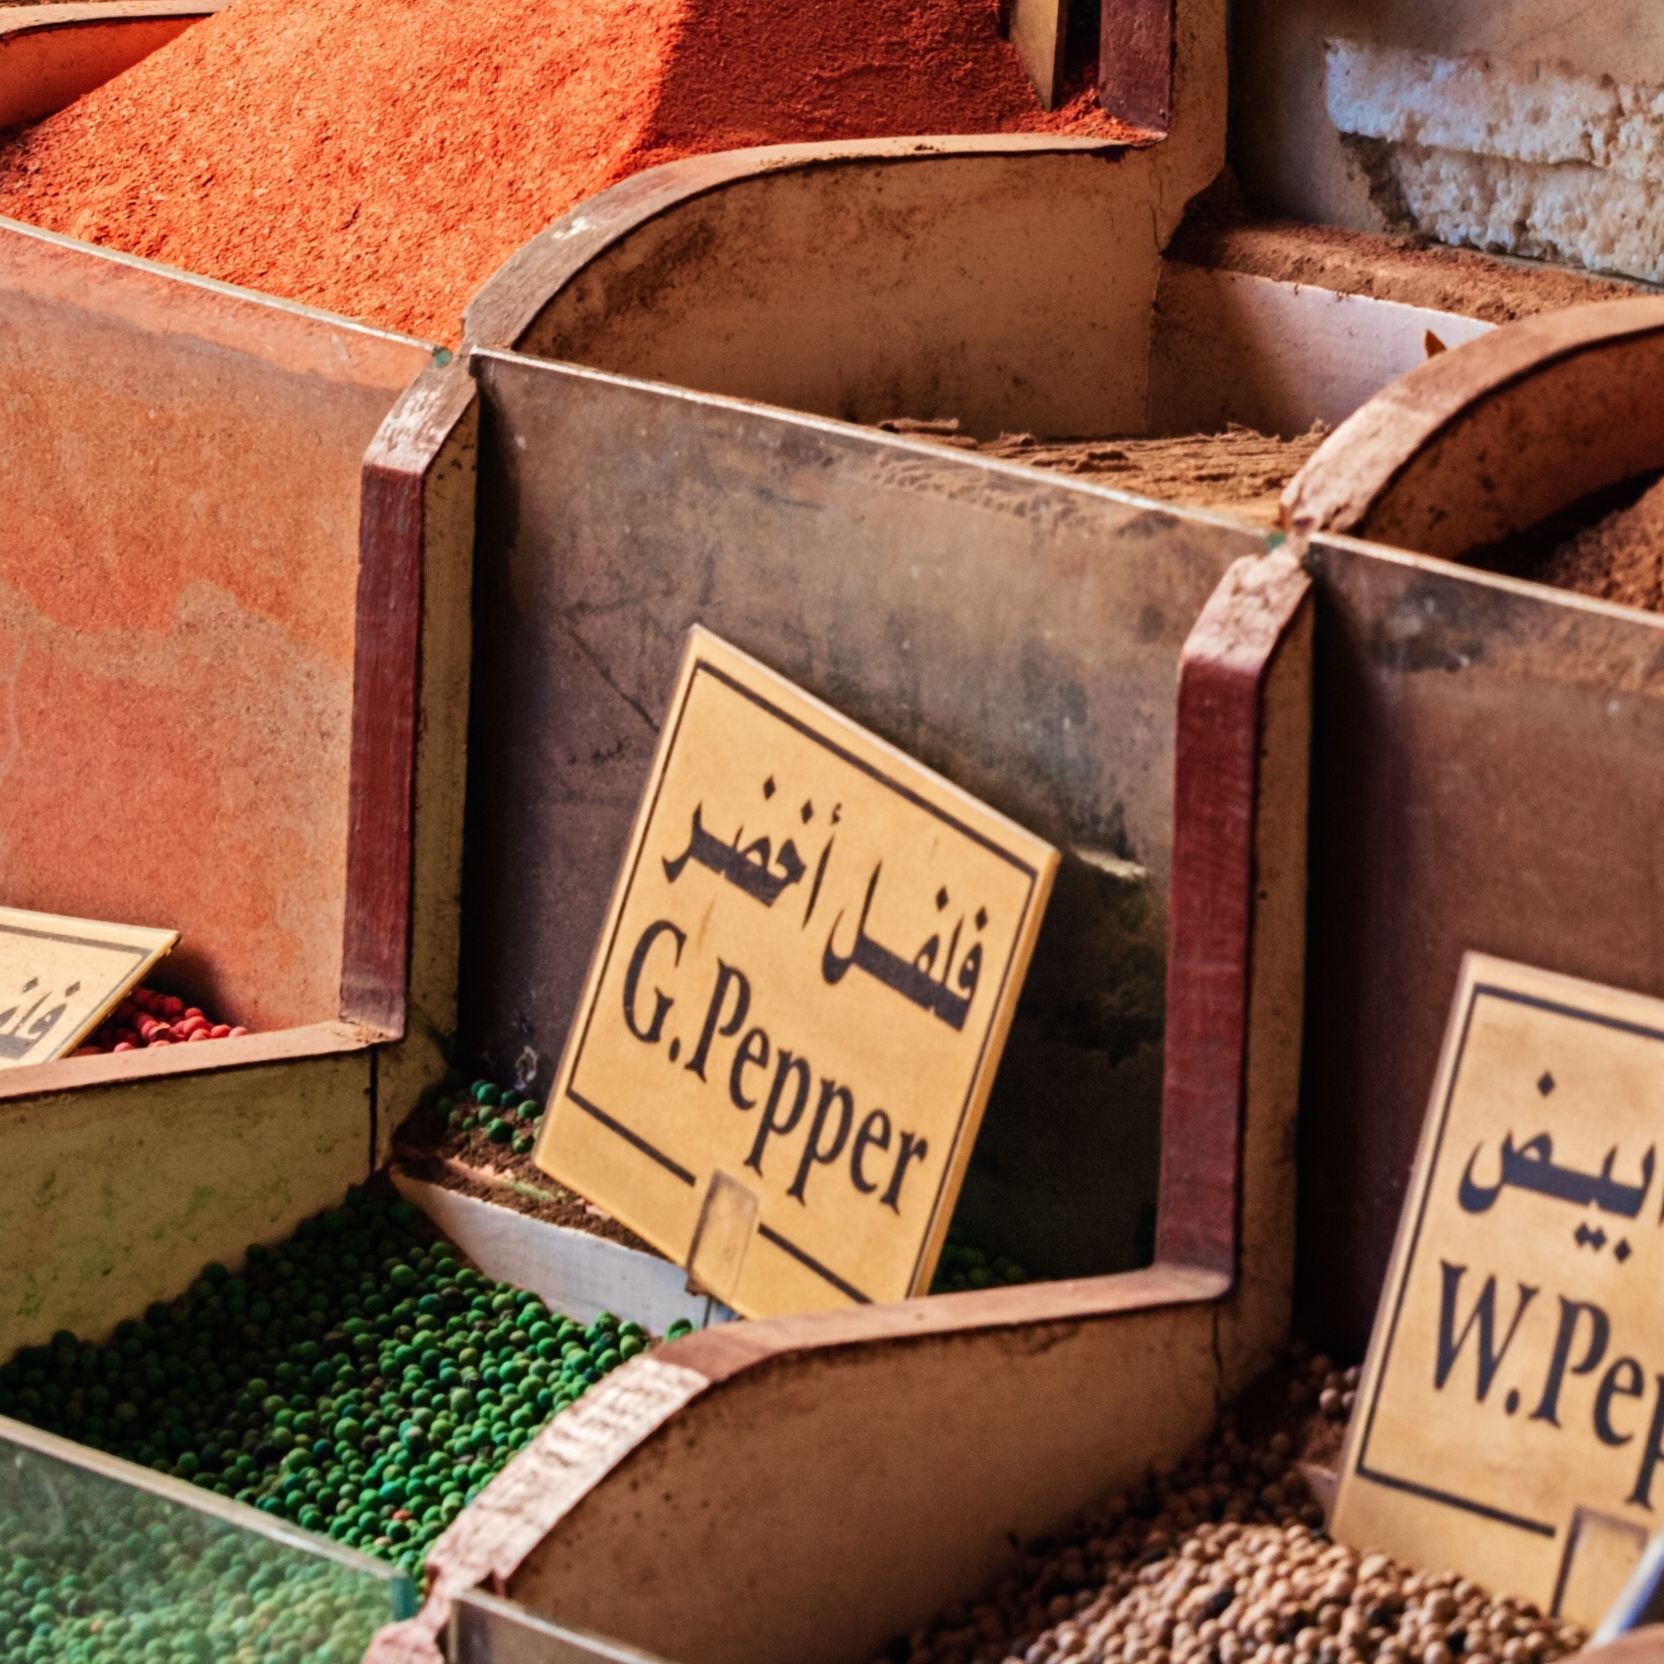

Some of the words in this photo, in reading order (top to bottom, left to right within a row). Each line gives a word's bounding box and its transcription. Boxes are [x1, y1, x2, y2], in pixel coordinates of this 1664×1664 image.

[662, 774, 844, 932] أخضر
[821, 860, 988, 1032] فلفل
[623, 918, 928, 1215] G.Pepper
